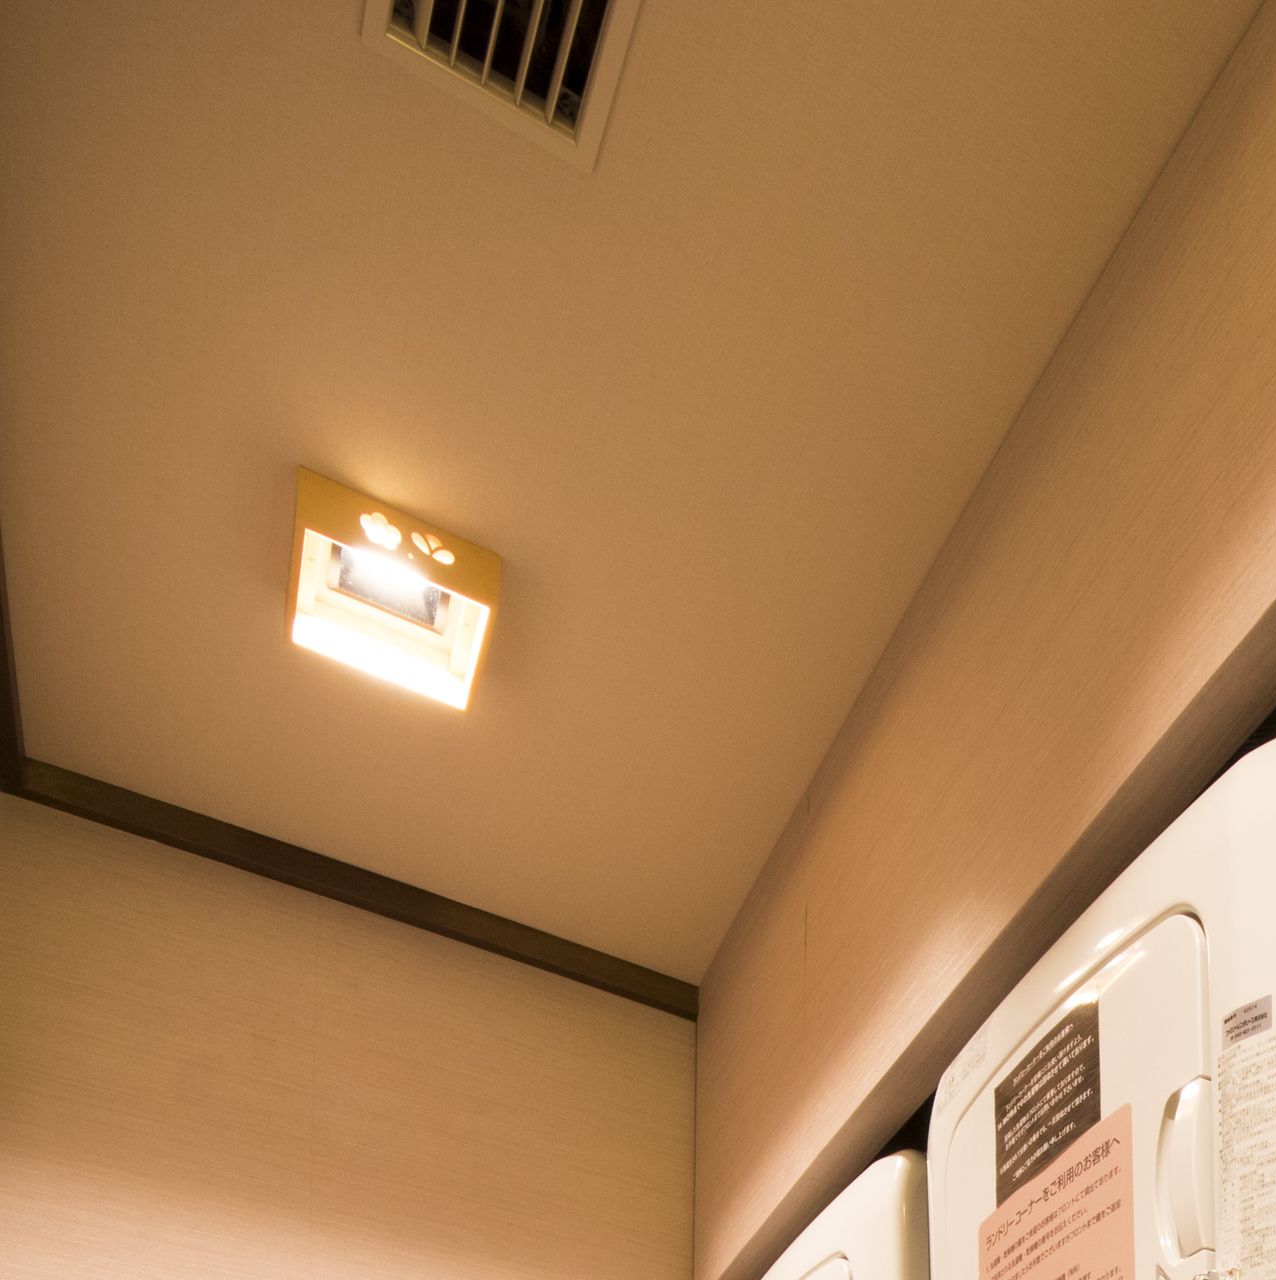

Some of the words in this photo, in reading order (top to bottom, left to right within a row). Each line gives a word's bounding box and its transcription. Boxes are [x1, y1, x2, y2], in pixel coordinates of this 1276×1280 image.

[985, 1130, 1120, 1251] ランドリーコーナーをご利用のお客様へ
